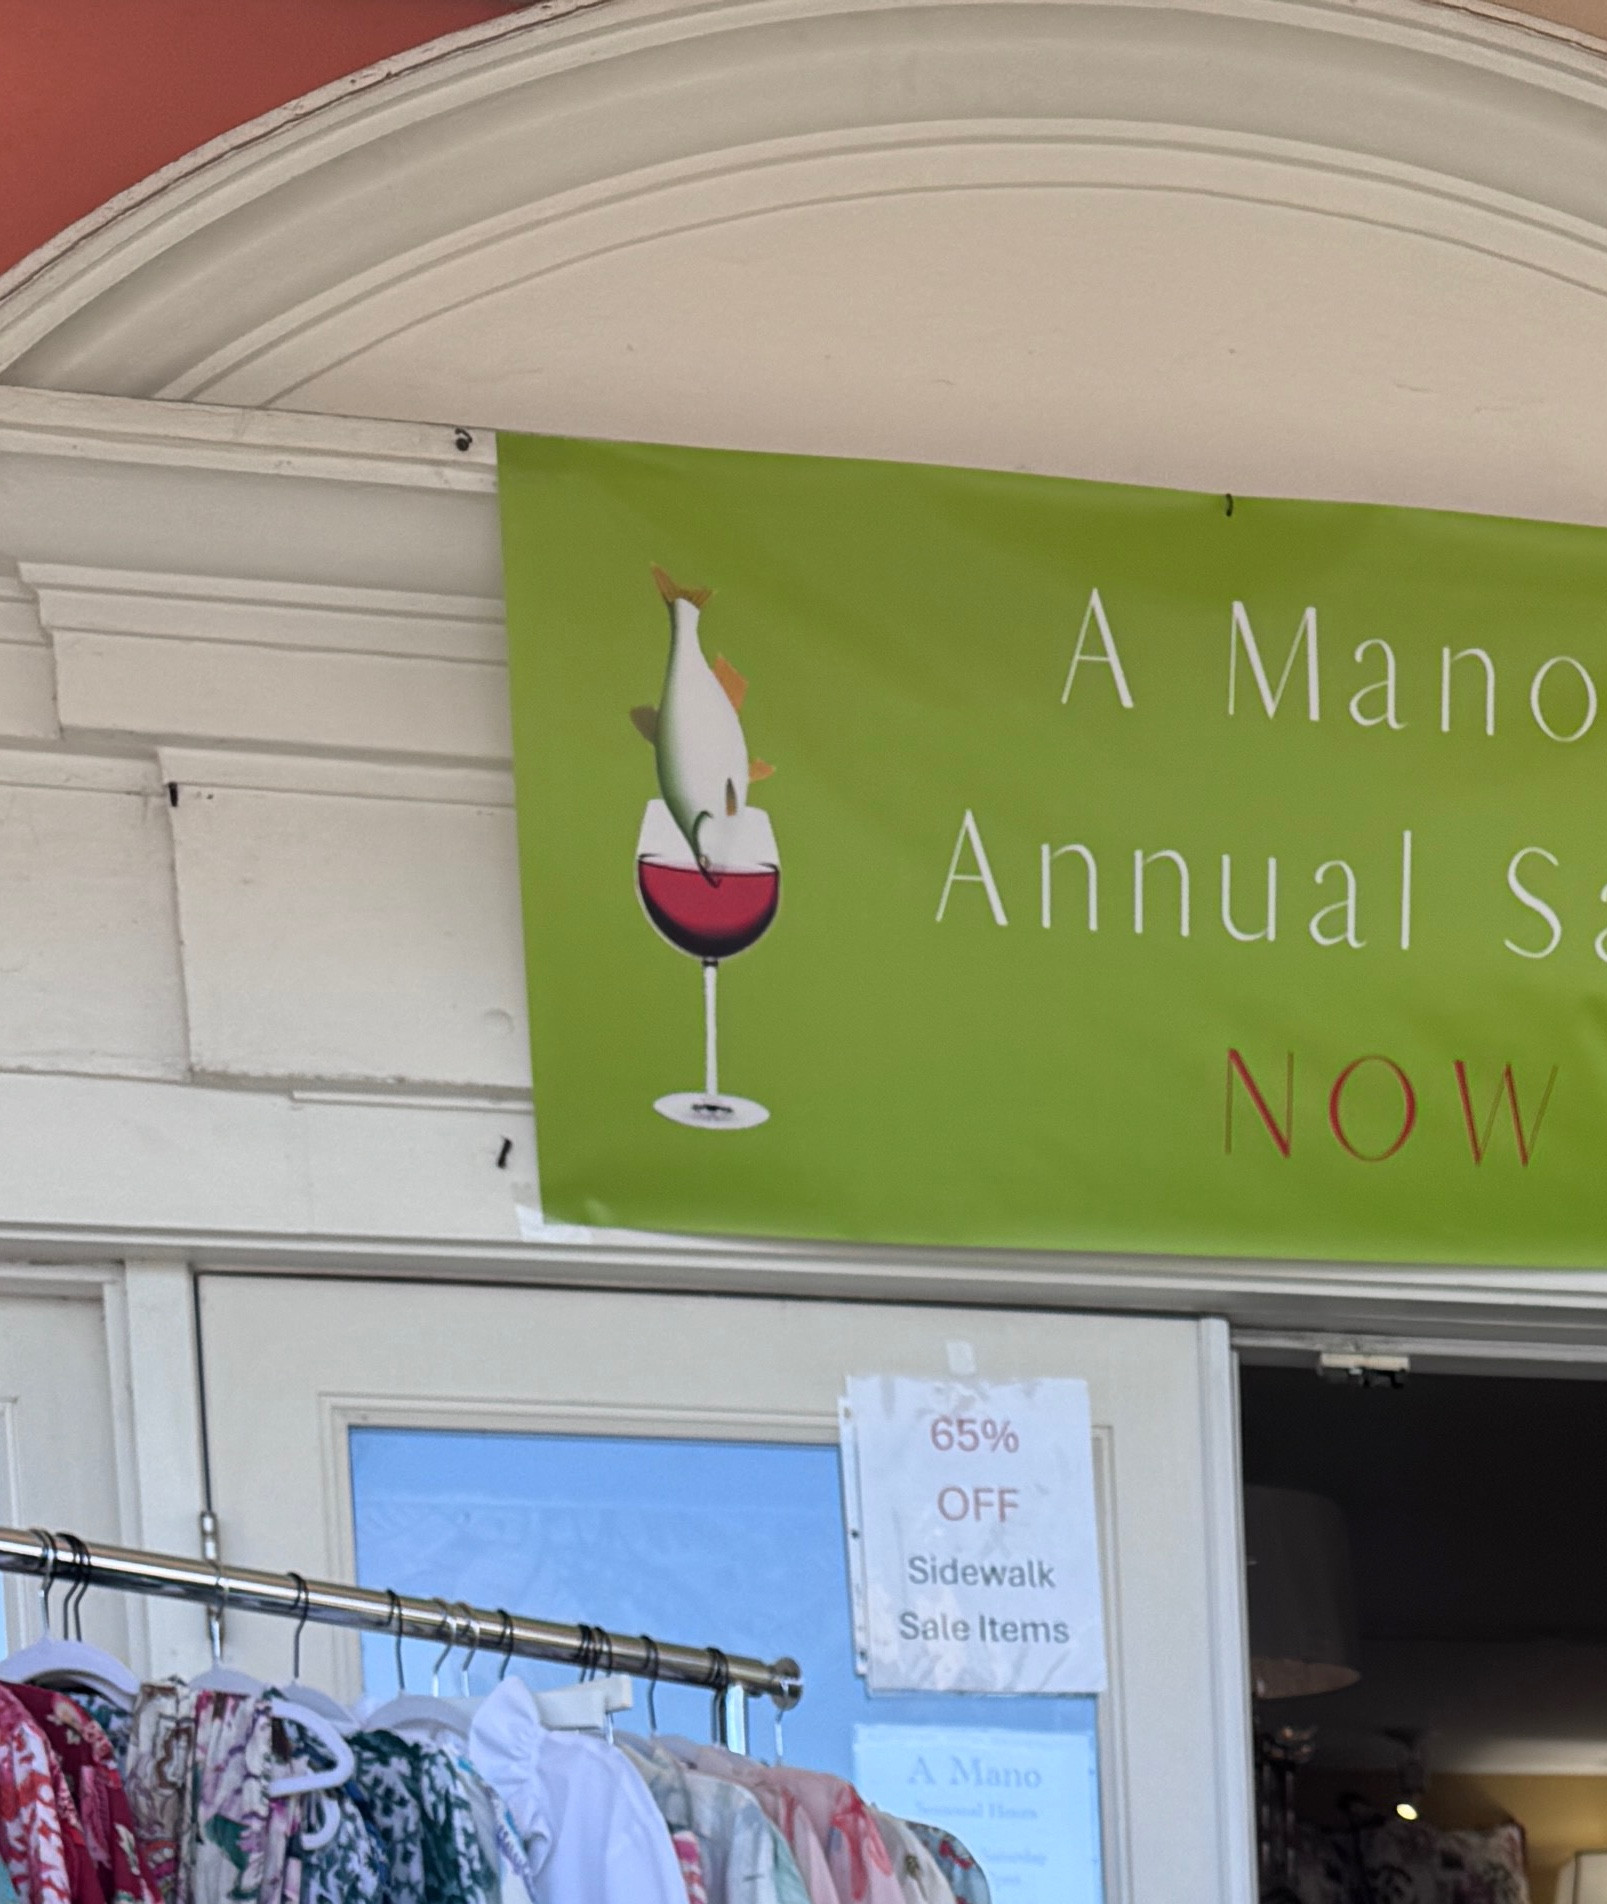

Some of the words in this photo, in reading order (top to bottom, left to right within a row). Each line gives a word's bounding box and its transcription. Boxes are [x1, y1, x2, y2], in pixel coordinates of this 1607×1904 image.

[1060, 587, 1135, 709] A
[936, 809, 1413, 951] Annual
[1223, 1046, 1558, 1170] NOW
[930, 1414, 1020, 1454] 65%
[937, 1485, 1020, 1522] OFF
[908, 1555, 1056, 1589] Sidewalk
[899, 1611, 971, 1642] Sale
[979, 1614, 1070, 1644] Items
[907, 1756, 936, 1787] A
[949, 1756, 1043, 1790] Mano
